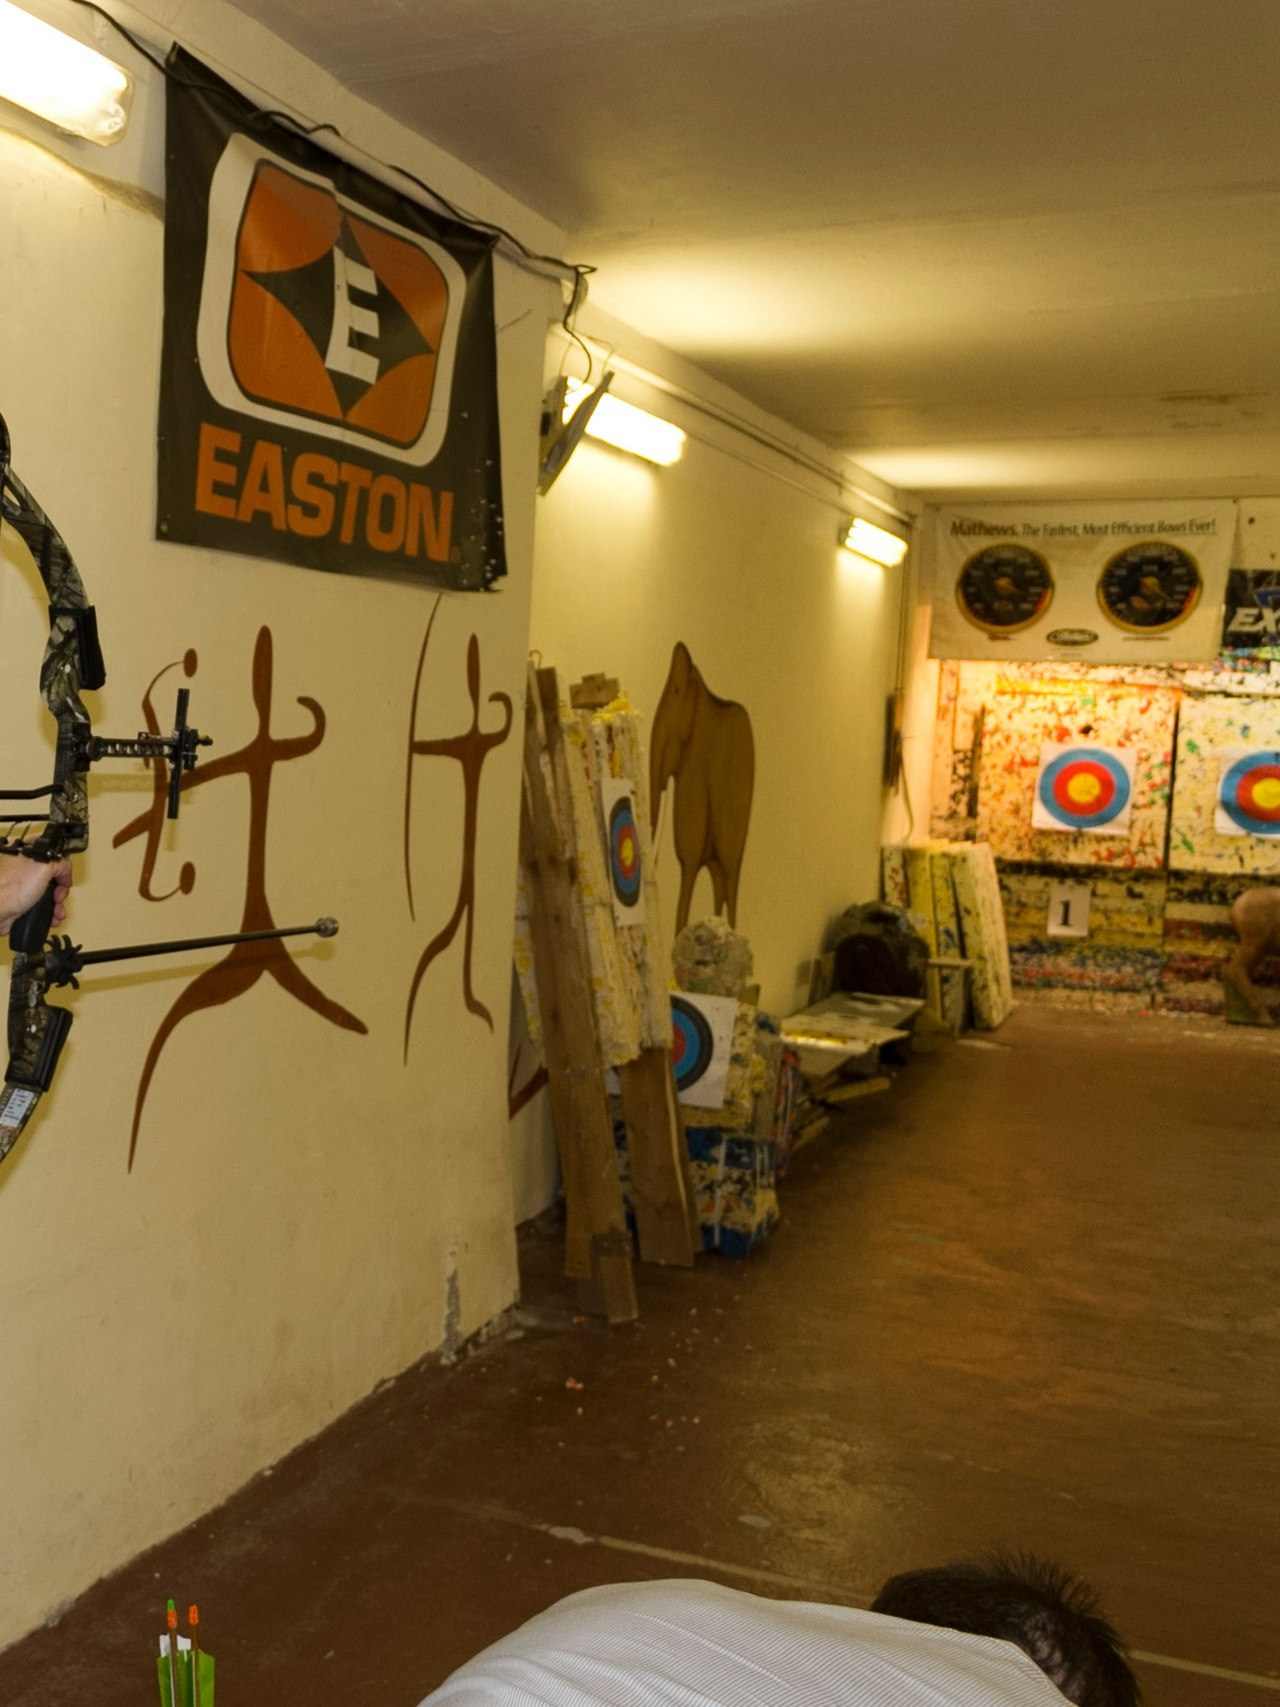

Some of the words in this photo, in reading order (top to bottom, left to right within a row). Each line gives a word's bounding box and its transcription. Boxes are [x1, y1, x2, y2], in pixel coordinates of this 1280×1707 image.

[324, 245, 381, 386] E
[195, 422, 455, 564] EASTON
[1022, 523, 1040, 537] The
[1083, 522, 1109, 536] Most
[1111, 520, 1154, 536] Efficient
[1157, 519, 1187, 534] Bows
[1189, 518, 1217, 533] Ever!
[1059, 899, 1074, 927] 1
